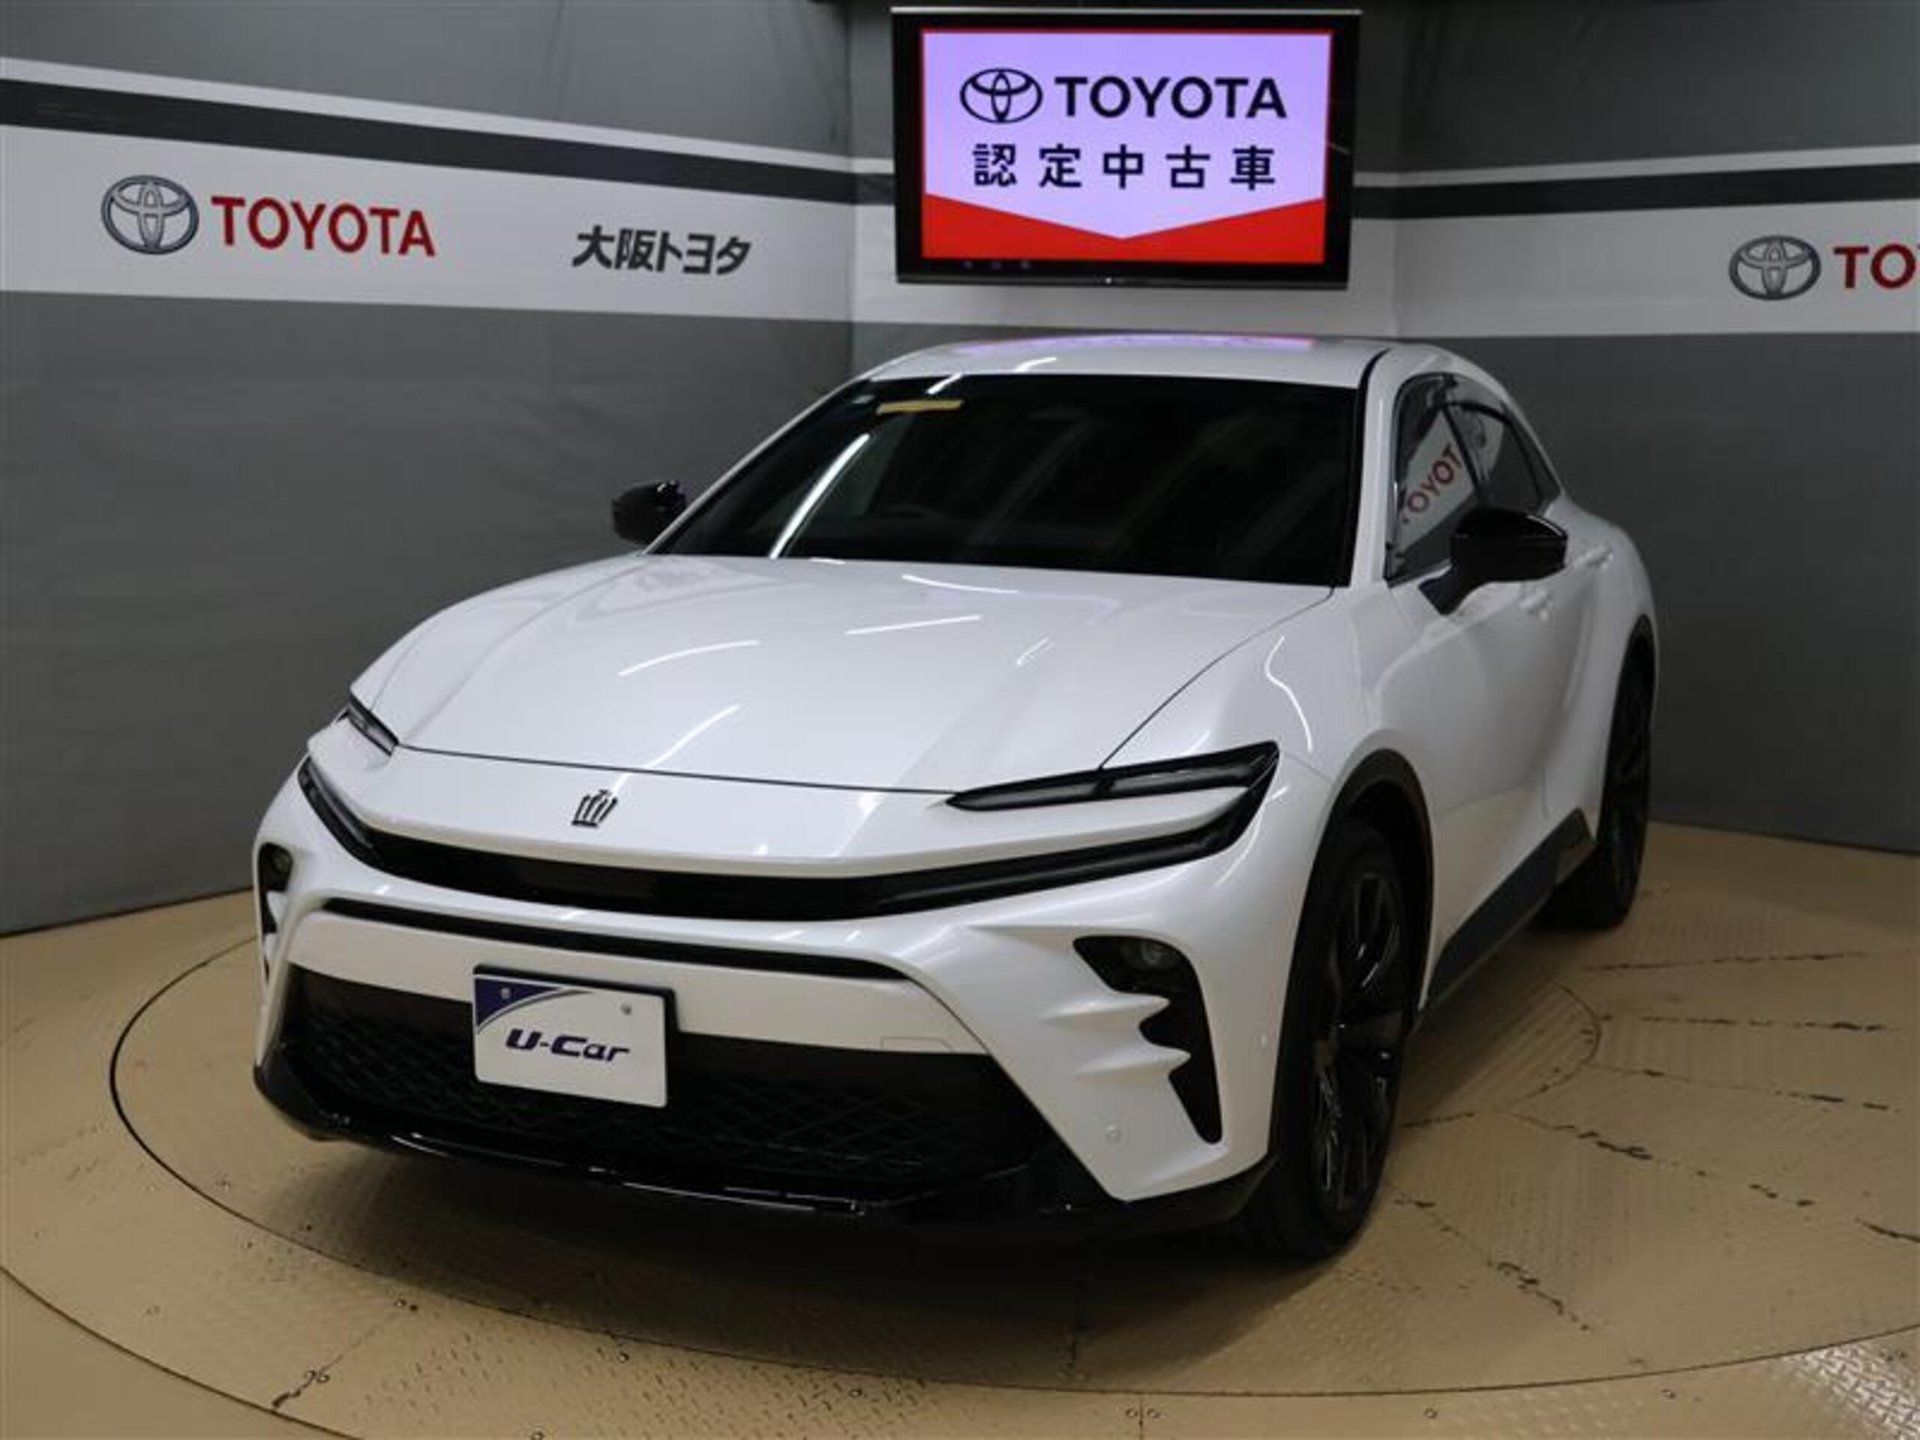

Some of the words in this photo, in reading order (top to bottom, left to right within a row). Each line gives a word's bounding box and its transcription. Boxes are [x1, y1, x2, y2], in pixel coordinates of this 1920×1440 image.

[1054, 75, 1287, 119] TOYOTA
[972, 142, 1276, 191] 認定中古車
[211, 194, 436, 258] TOYOTA
[571, 224, 752, 276] 大阪トヨタ
[1833, 243, 1920, 290] TO
[505, 1028, 631, 1063] U-Car
